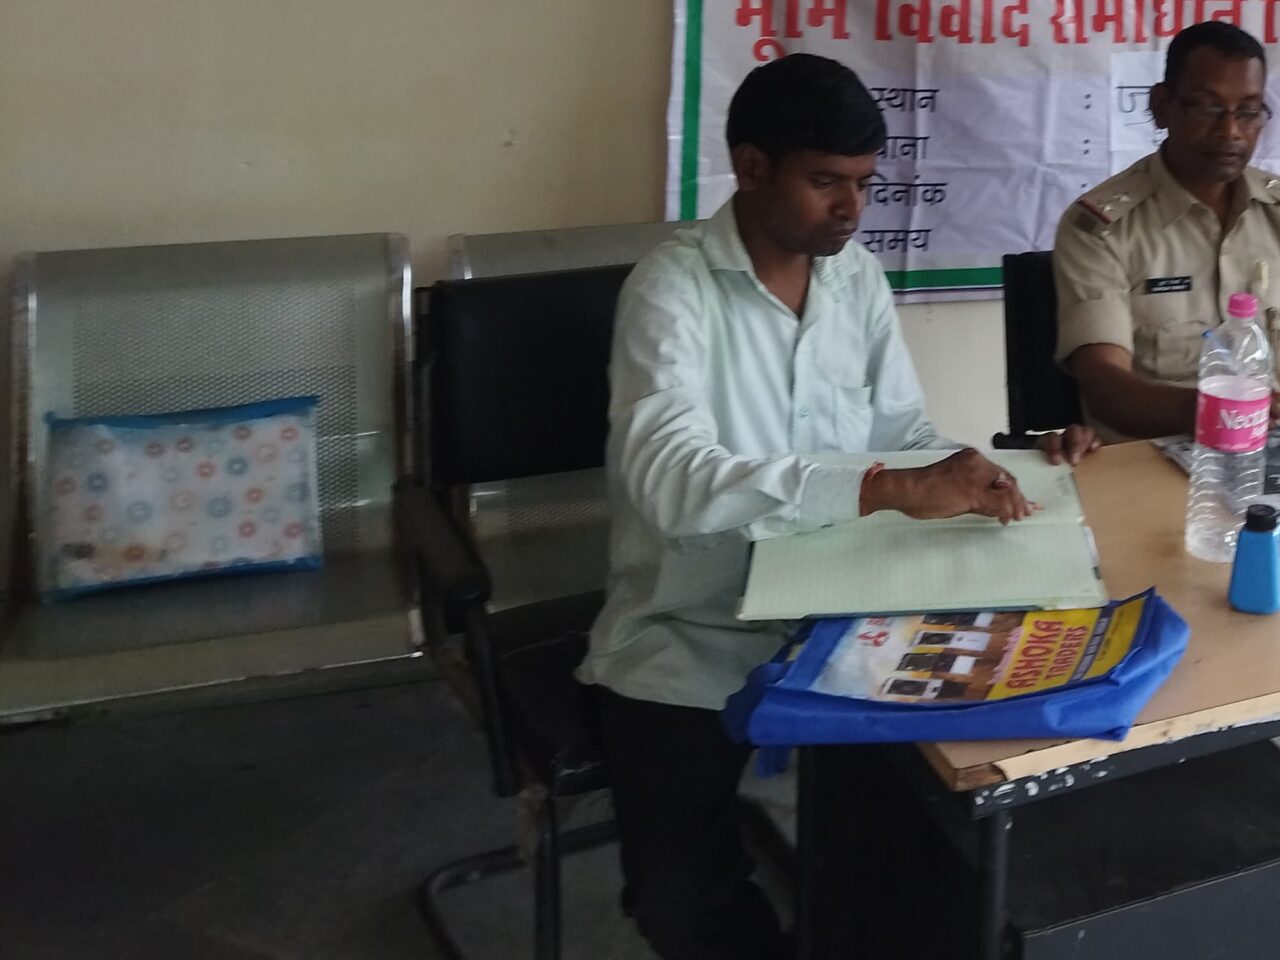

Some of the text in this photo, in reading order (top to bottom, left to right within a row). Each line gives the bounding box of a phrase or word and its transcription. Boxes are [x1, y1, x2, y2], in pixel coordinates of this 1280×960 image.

[861, 229, 933, 254] समय
[1006, 620, 1064, 689] ASHOKA
[1045, 625, 1089, 680] TRADERS
